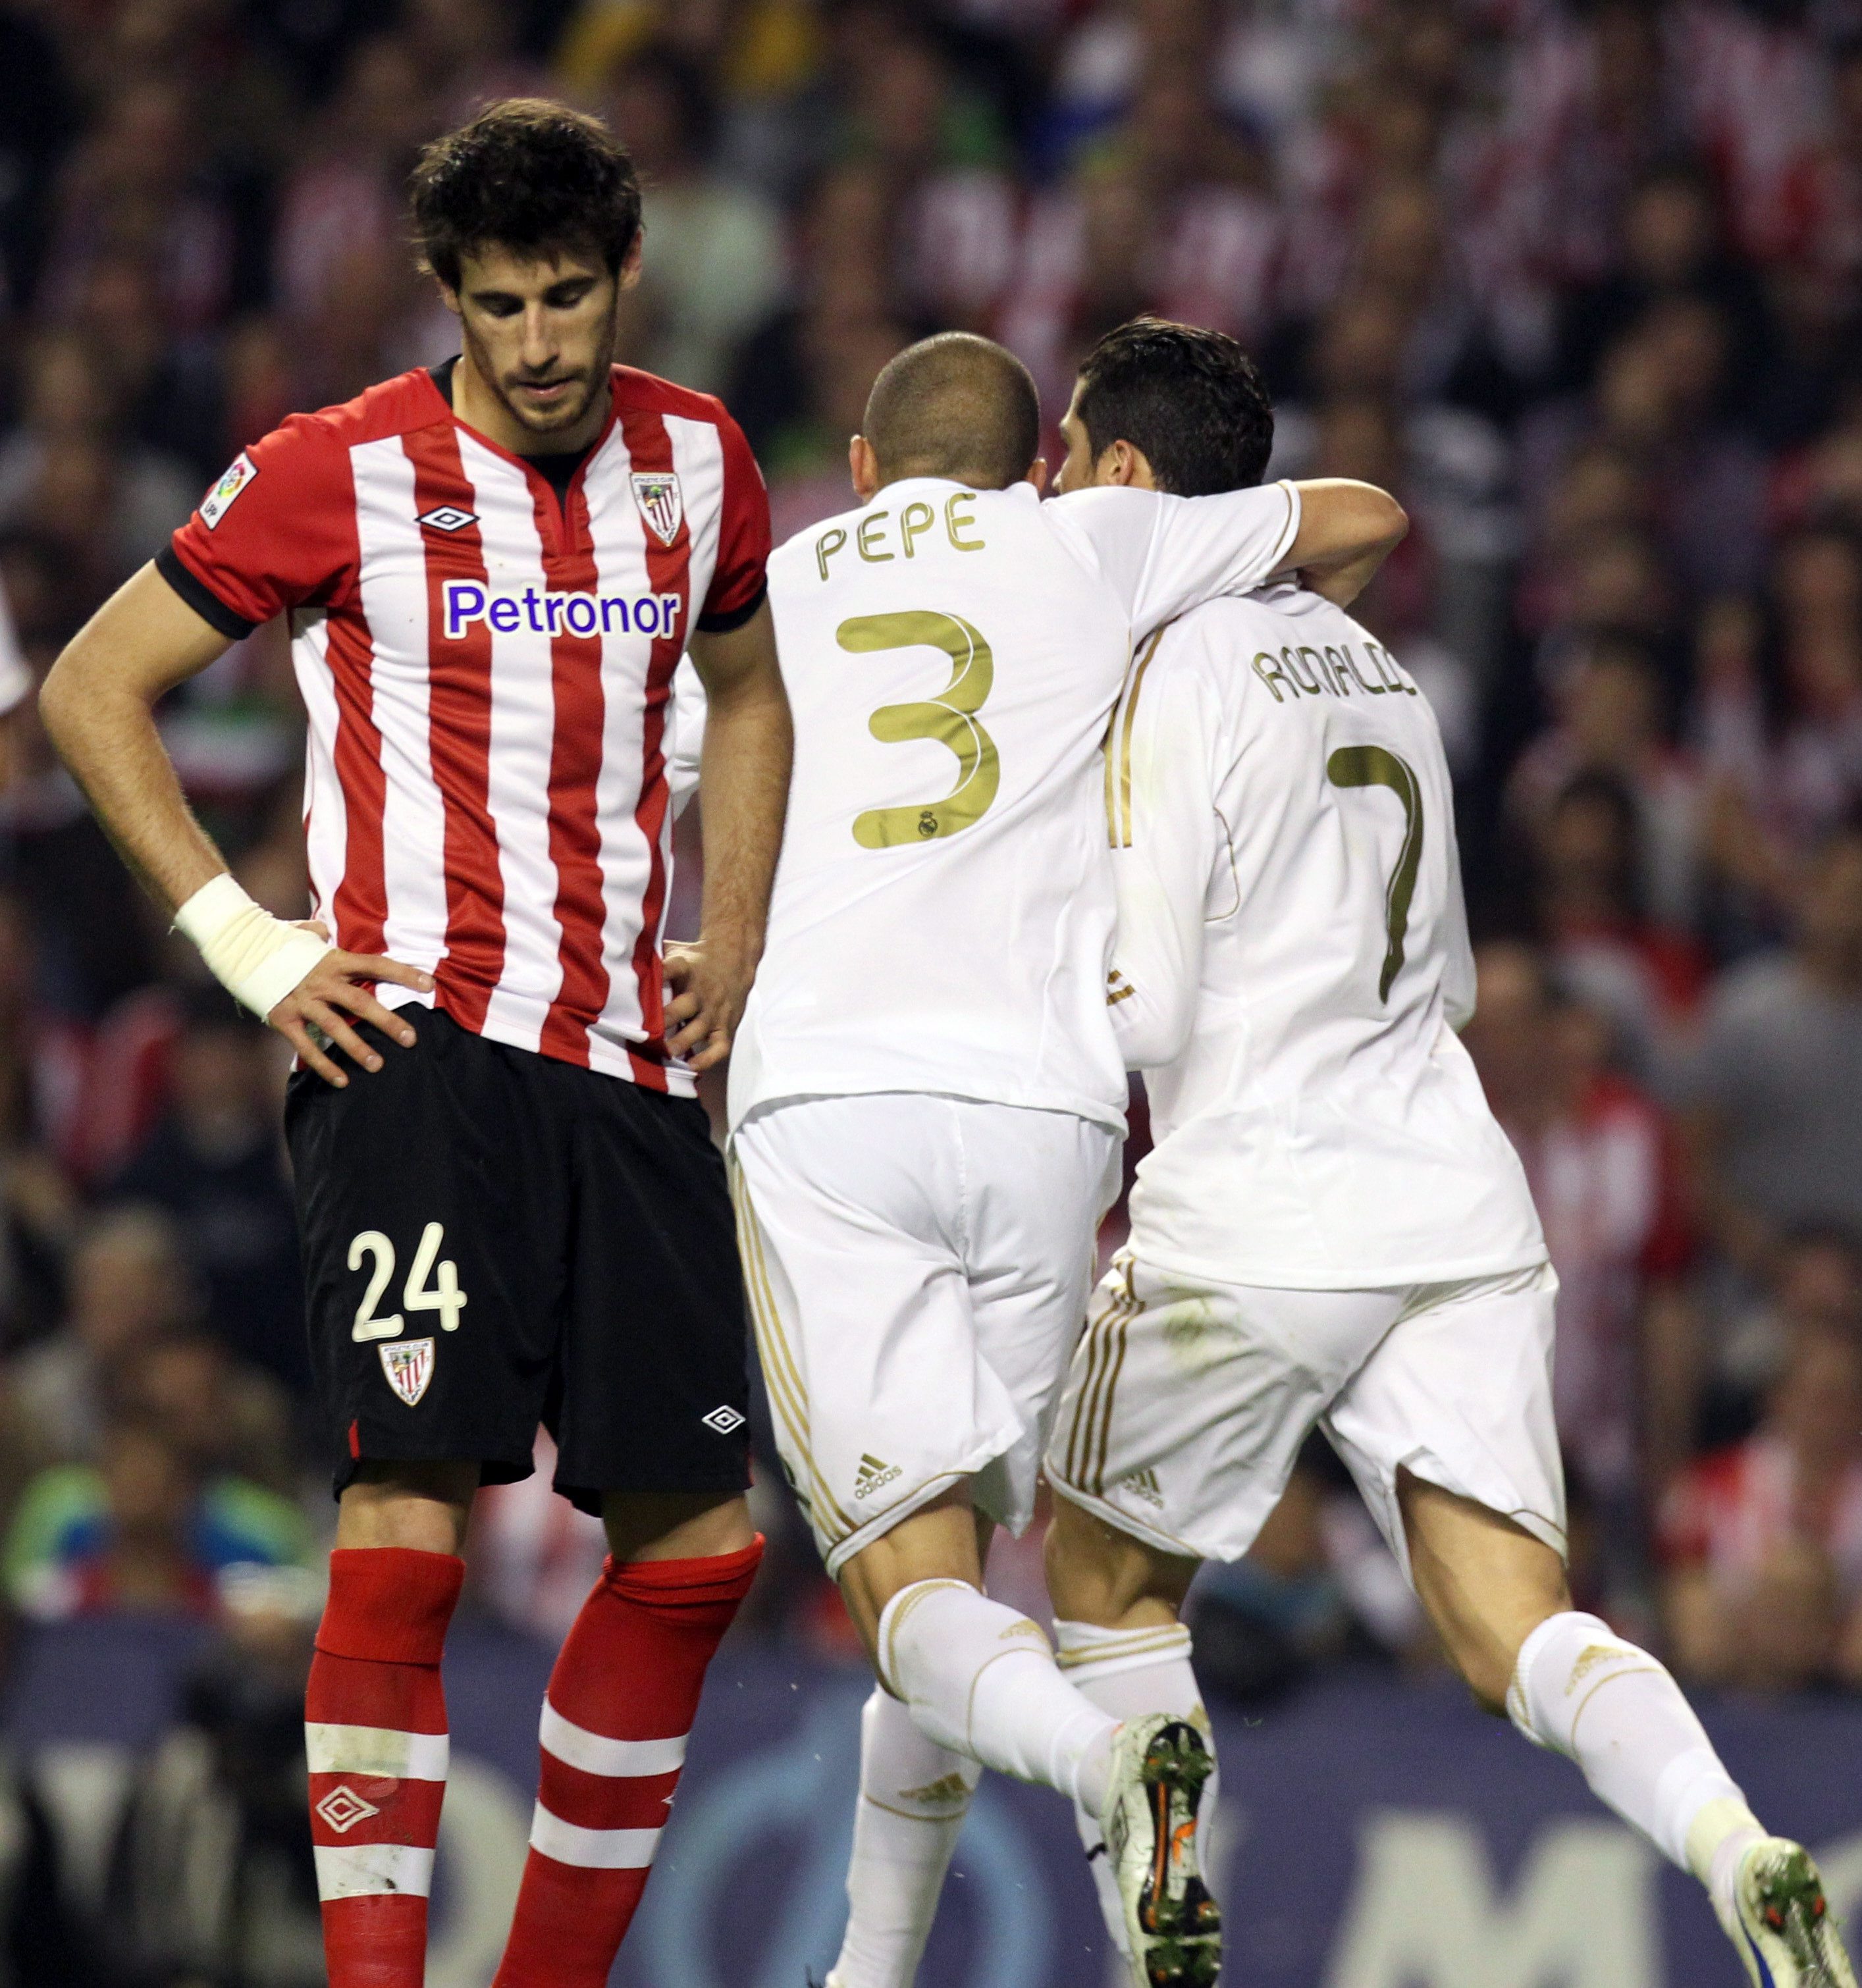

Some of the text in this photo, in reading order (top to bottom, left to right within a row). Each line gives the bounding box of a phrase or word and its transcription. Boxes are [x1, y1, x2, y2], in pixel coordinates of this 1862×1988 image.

[816, 493, 985, 581] PEPE
[447, 586, 677, 633] Petronor
[836, 610, 1001, 849] 3
[1326, 745, 1423, 1005] 7
[347, 1221, 468, 1343] 24
[855, 1465, 903, 1500] adidas
